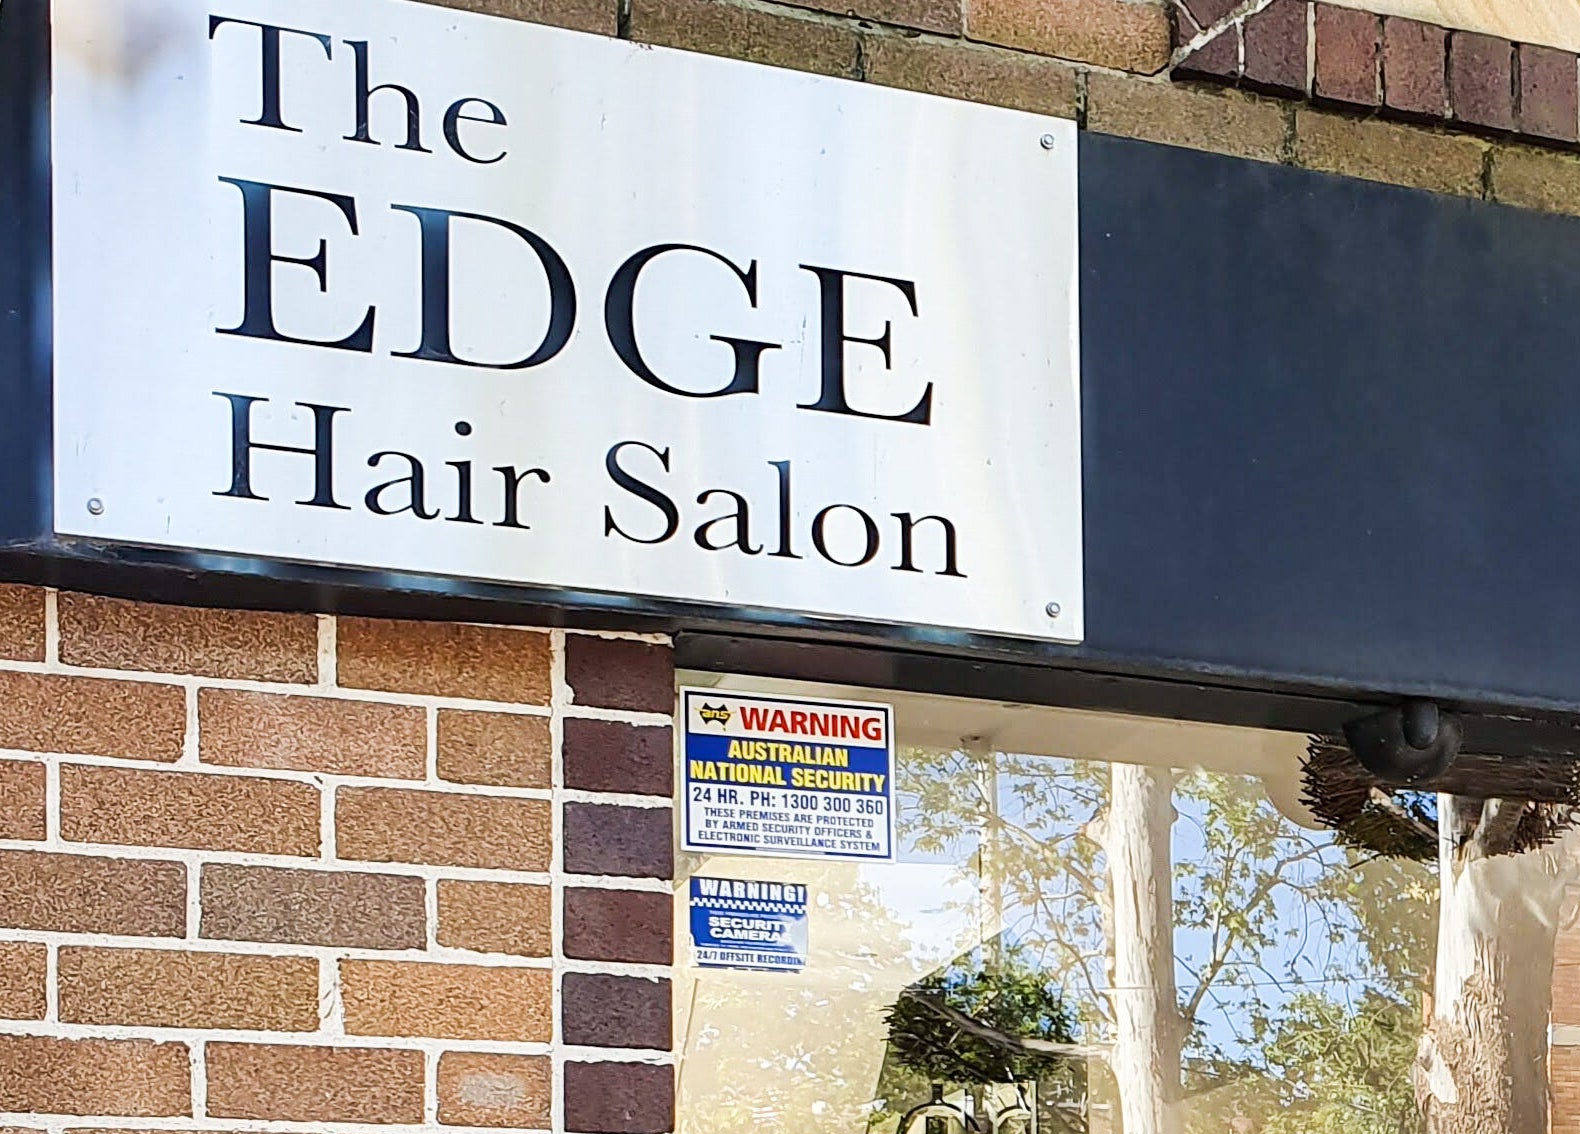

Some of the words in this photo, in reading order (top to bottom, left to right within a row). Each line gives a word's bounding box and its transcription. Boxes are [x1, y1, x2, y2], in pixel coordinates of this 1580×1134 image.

[208, 14, 508, 164] The
[215, 176, 933, 427] EDGE
[212, 391, 551, 530] Hair
[604, 440, 968, 578] Salon
[740, 707, 882, 740] WARNING
[728, 740, 848, 767] AUSTRALIAN
[690, 760, 787, 785] NATIONAL
[791, 768, 885, 793] SECURITY
[693, 787, 711, 802] 24
[718, 789, 743, 805] HR.
[750, 792, 776, 807] PH:
[782, 794, 818, 810] 1300
[824, 796, 850, 812] 300
[856, 799, 883, 814] 360
[704, 807, 735, 818] THESE
[739, 810, 790, 821] PREMISES
[794, 814, 813, 824] ARE
[816, 815, 873, 827] PROTECTED
[706, 820, 718, 828] BY
[722, 821, 758, 831] ARMED
[762, 824, 810, 835] SECURITY
[814, 827, 862, 838] OFFICERS
[866, 830, 872, 839] &
[698, 830, 760, 843] ELECTRONIC
[764, 835, 836, 848] SURVEILLANCE
[840, 841, 880, 850] SYSTEM
[699, 878, 805, 903] WARNING!
[708, 916, 791, 931] SECURITY
[709, 928, 792, 942] CAMERAS
[697, 950, 717, 960] 24/7
[720, 952, 754, 962] OFFSITE
[757, 954, 805, 965] RECORDIN
